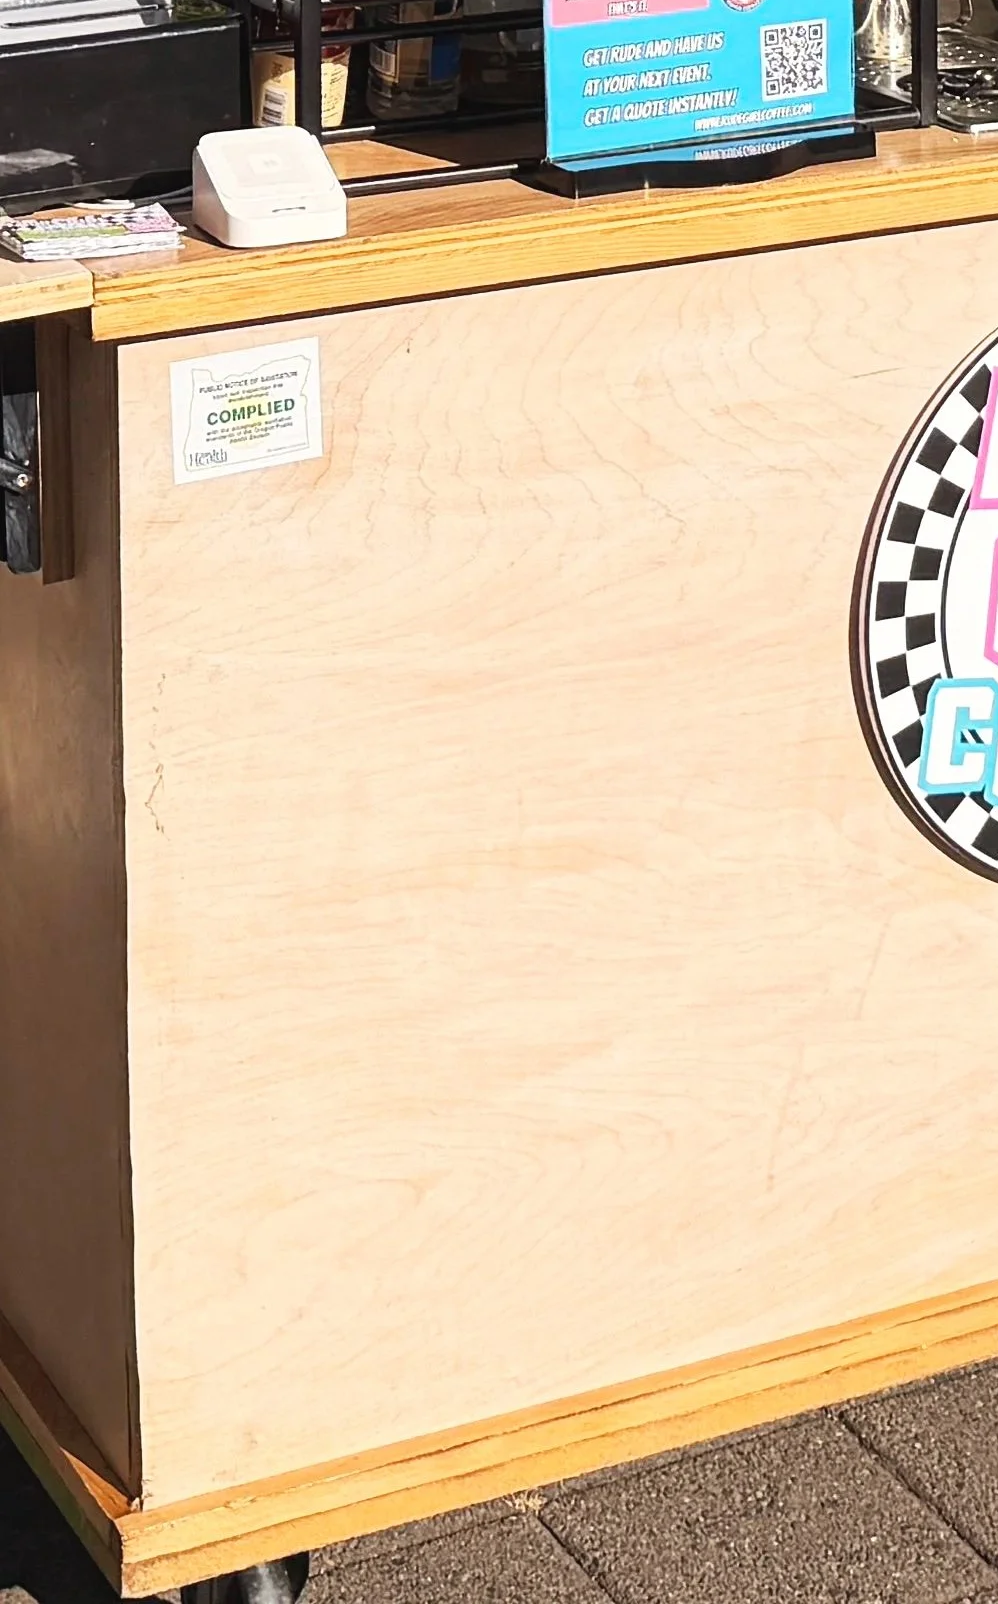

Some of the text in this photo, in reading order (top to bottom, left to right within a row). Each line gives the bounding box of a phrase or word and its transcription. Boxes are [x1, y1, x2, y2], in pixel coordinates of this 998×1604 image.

[583, 31, 725, 68] GET RUDE AND HAVE US
[583, 62, 712, 97] AT YOUR NEXT EVENT.
[584, 87, 739, 127] GET A QUOTE INSTANTLY!
[207, 398, 295, 426] COMPLIED
